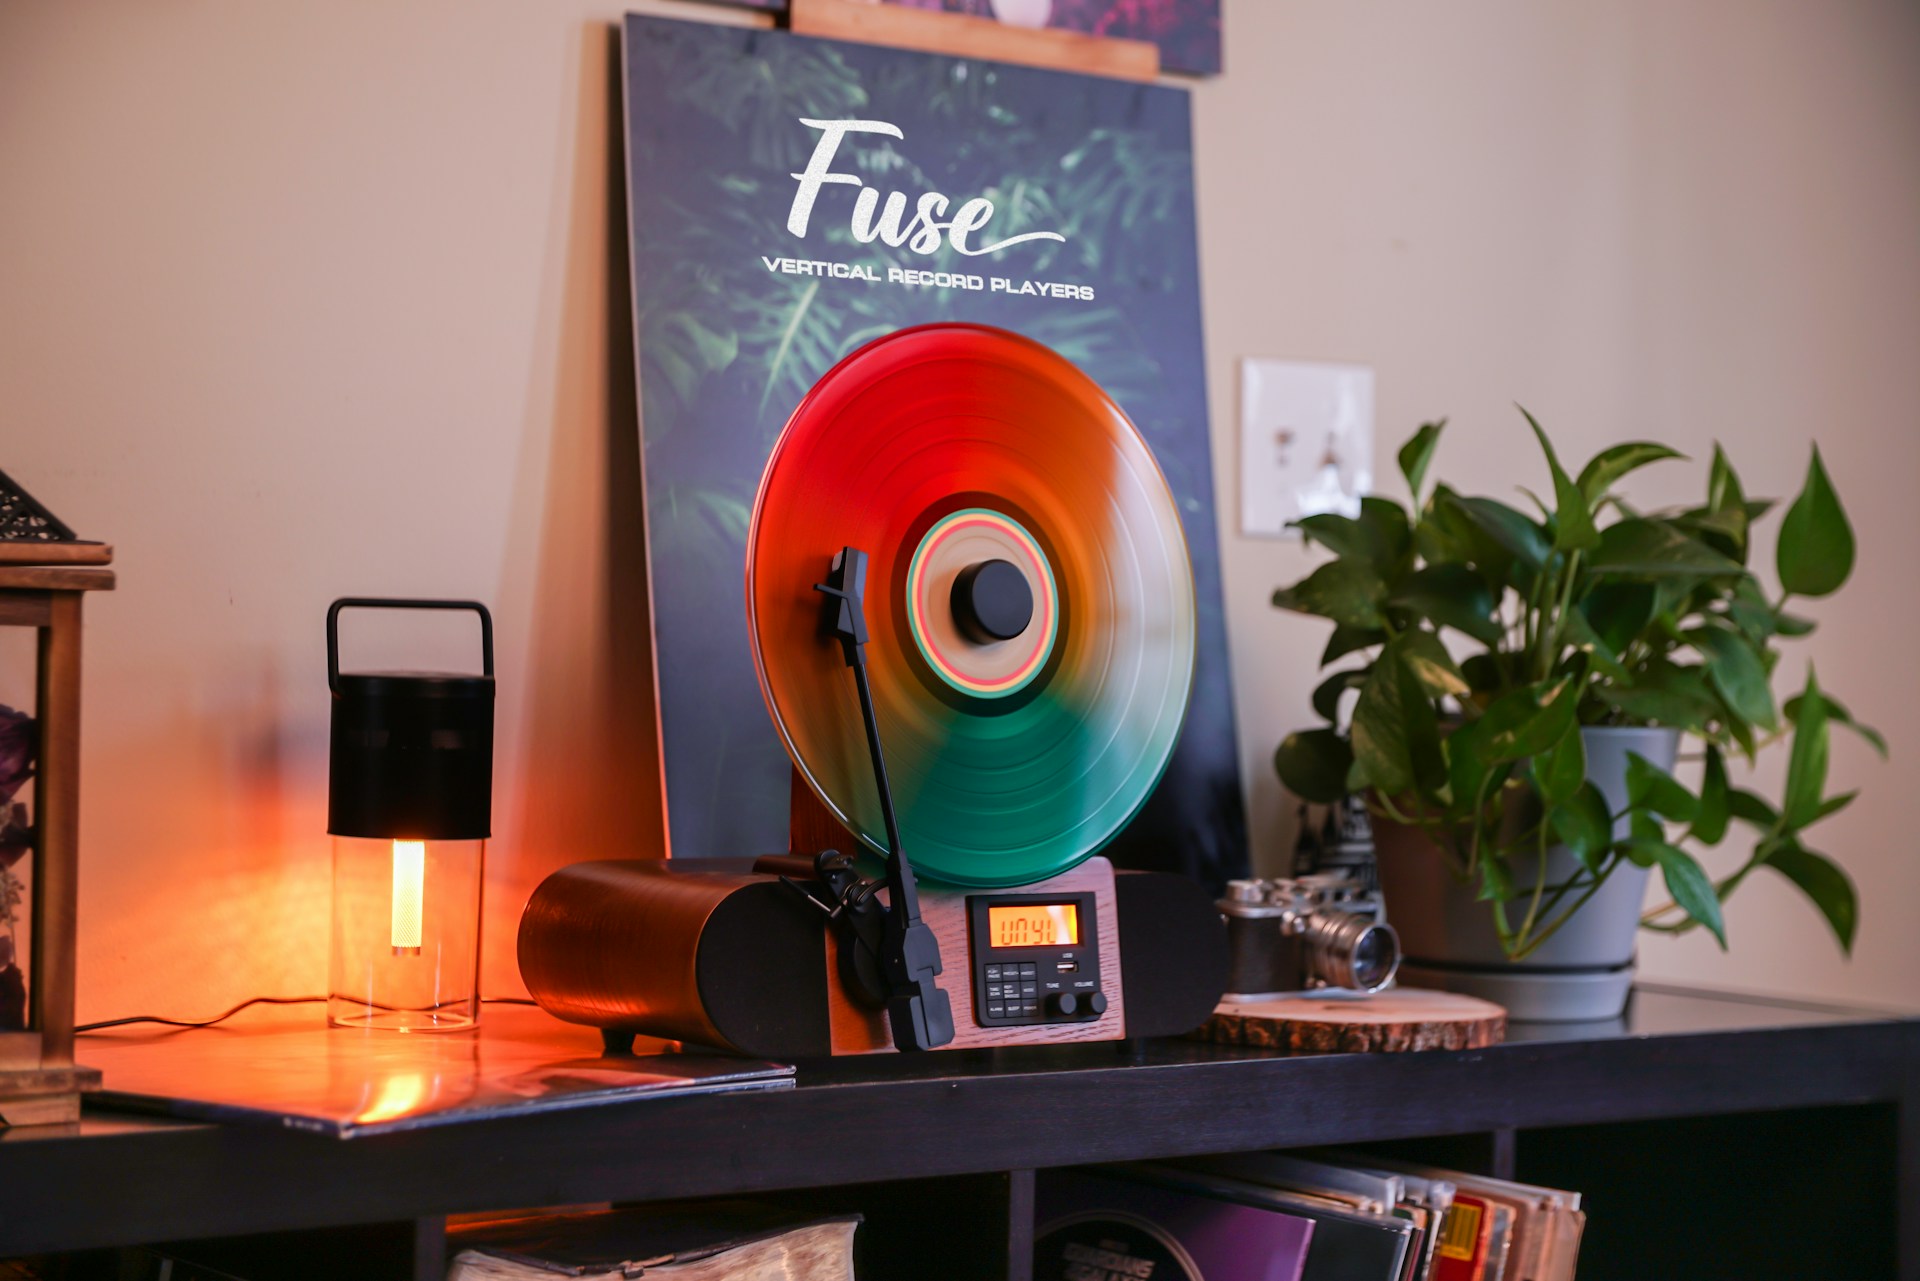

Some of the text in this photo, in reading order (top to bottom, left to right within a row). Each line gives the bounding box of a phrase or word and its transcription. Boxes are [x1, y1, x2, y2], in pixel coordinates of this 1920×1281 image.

[787, 117, 1066, 256] Fuse
[761, 256, 1095, 301] VERTICAL RECORD PLAYERS
